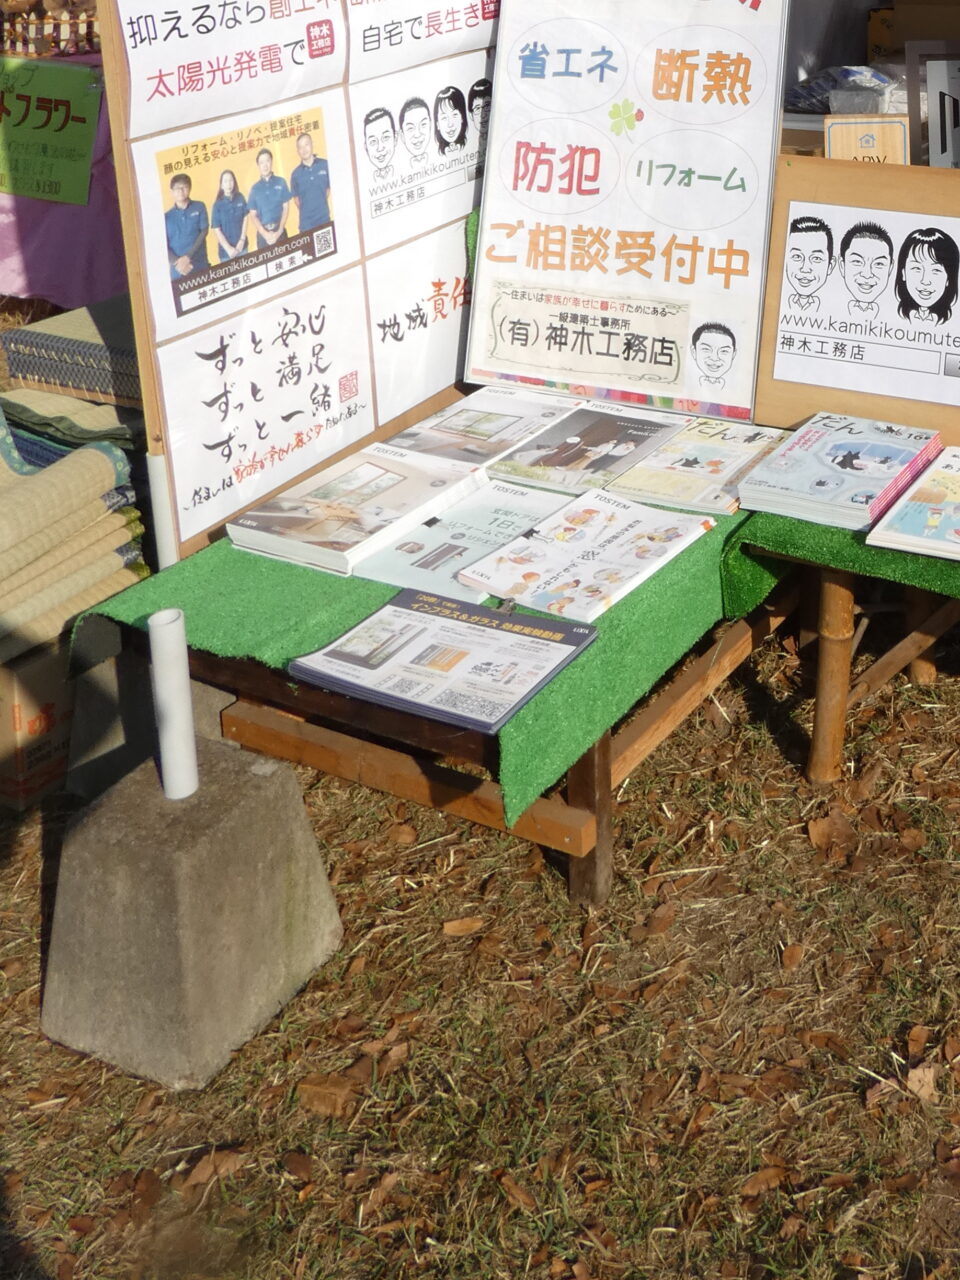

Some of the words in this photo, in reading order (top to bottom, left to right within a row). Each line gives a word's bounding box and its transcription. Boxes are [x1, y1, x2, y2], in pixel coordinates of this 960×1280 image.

[363, 3, 480, 53] 自宅で長生き
[146, 39, 305, 102] 太陽光発電で
[518, 42, 619, 83] 省エネ
[652, 48, 753, 106] 断熱
[512, 141, 600, 195] 防犯
[635, 159, 747, 193] リフォーム
[485, 220, 750, 290] ご相談受付中
[549, 312, 631, 331] 一級建築士事務所
[780, 334, 866, 361] 神木工務店
[590, 402, 624, 414] TOSTEM
[812, 414, 863, 436] だん
[372, 446, 408, 458] TOSTEM
[492, 484, 528, 497] TOSTEM
[593, 494, 632, 510] TOSTEM
